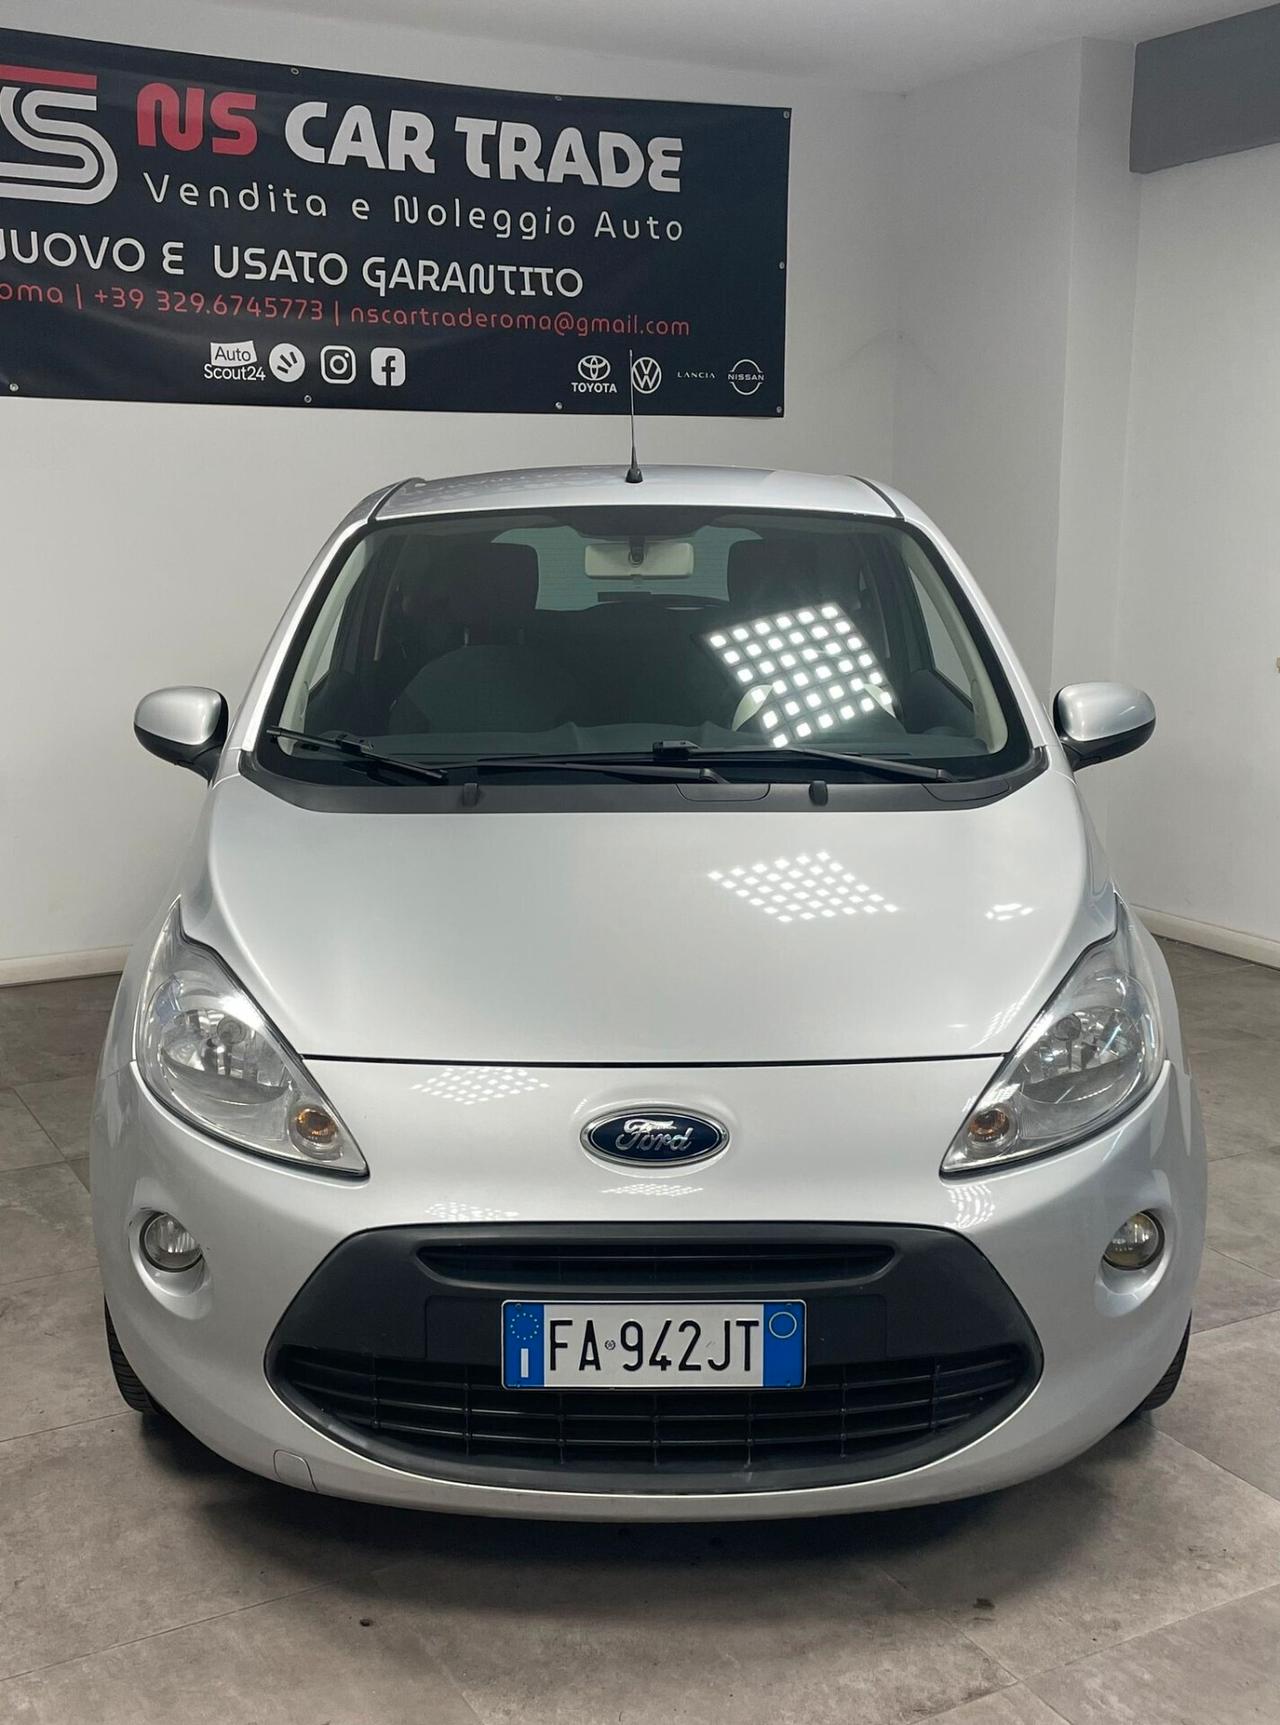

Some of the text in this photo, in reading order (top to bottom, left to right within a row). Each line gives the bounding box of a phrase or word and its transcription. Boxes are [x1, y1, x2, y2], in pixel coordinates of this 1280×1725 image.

[136, 82, 683, 193] NS CAR TRADE
[143, 172, 683, 241] Vendita e Noleggio Auto
[162, 241, 185, 275] E
[213, 244, 348, 286] USATO
[362, 256, 584, 298] GARANTITO
[94, 286, 144, 310] +39
[156, 290, 323, 321] 329.6745773
[351, 306, 691, 337] nscartraderoma@gmail.com
[214, 346, 252, 362] Auto
[203, 363, 267, 382] Scout24
[677, 371, 716, 380] LANCIA
[727, 373, 765, 382] NISSAN
[571, 382, 618, 393] TOYOTA
[615, 1118, 694, 1151] Ford
